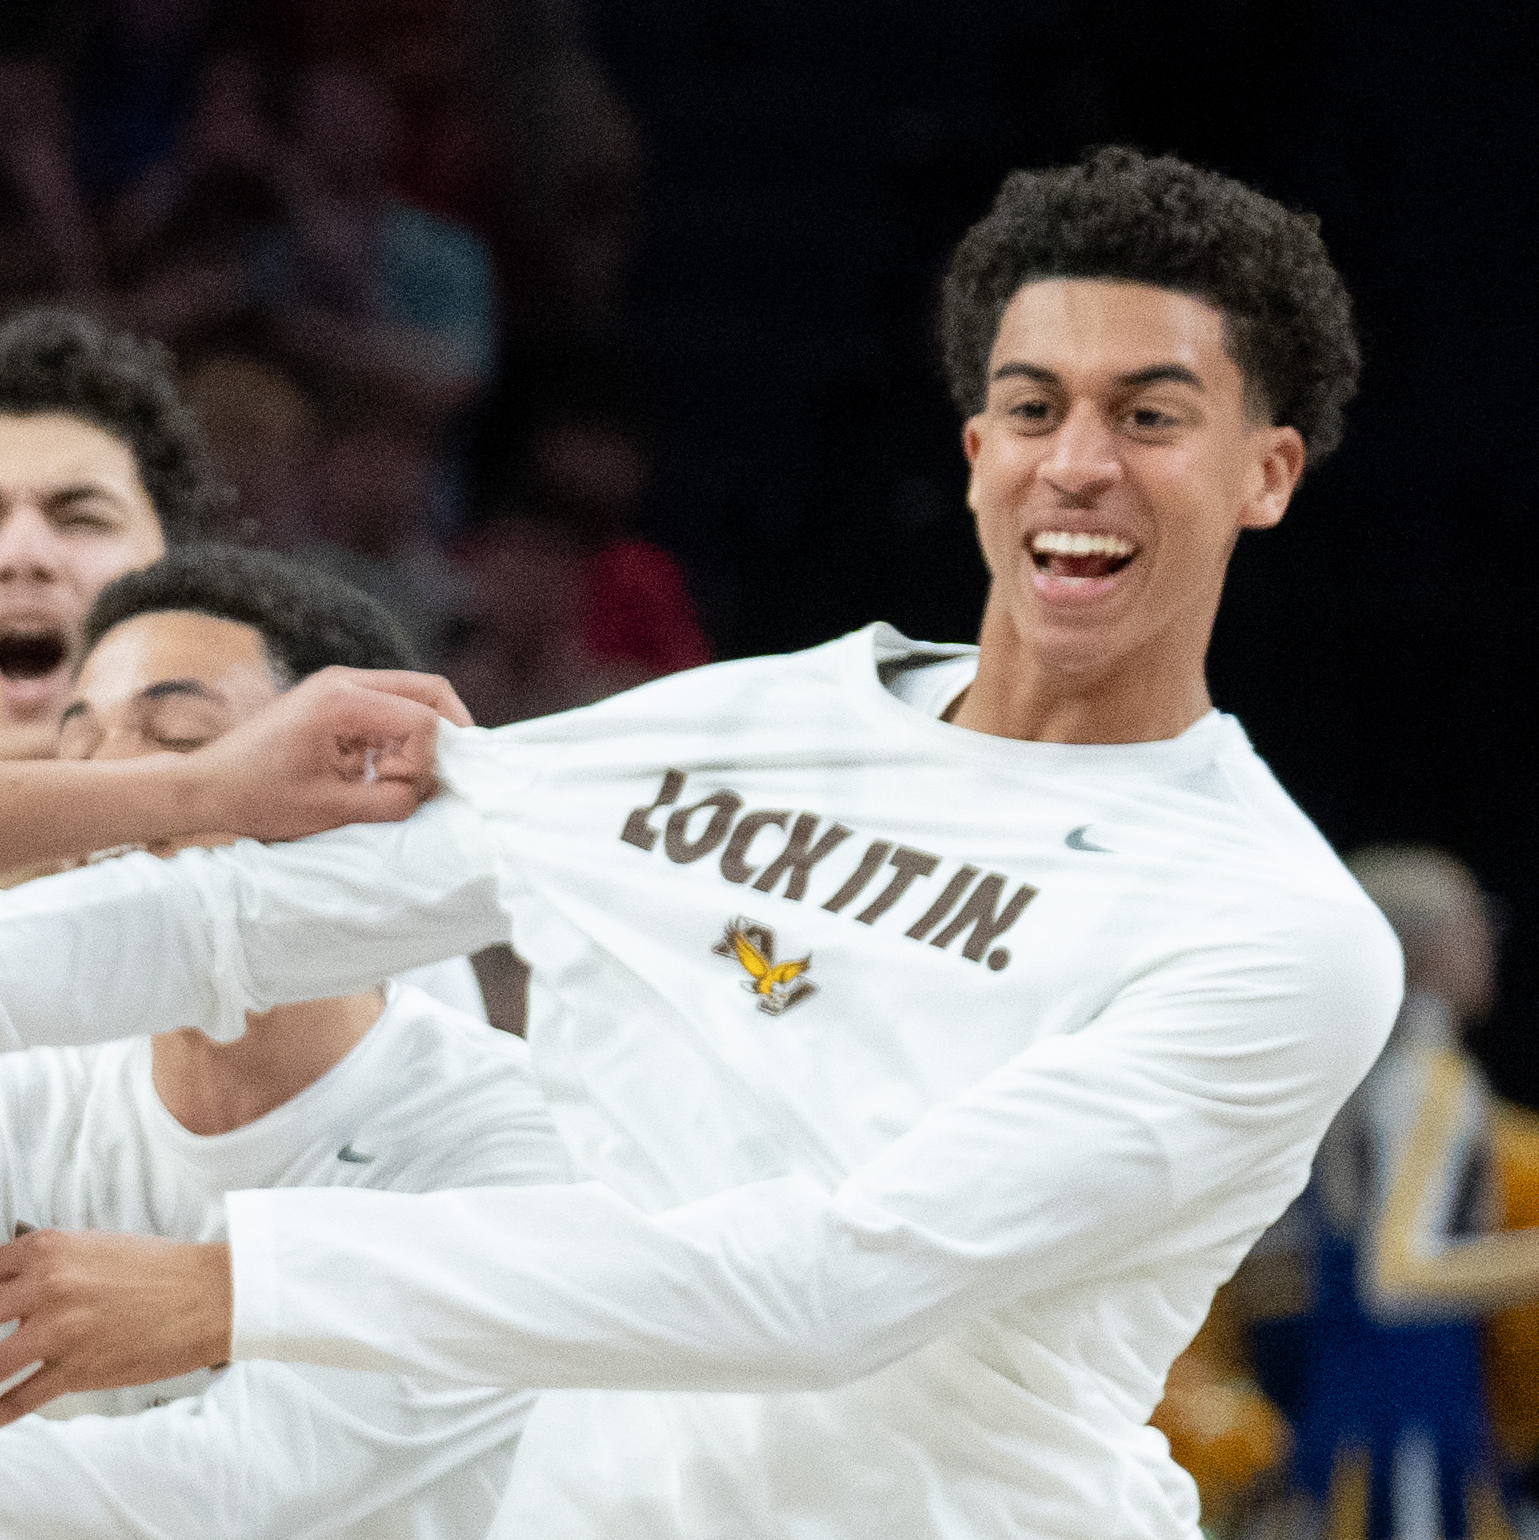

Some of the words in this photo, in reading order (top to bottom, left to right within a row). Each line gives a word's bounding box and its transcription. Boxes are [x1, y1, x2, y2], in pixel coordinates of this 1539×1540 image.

[621, 768, 854, 902] LOCK
[820, 839, 943, 926] IT
[904, 864, 1040, 972] IN.
